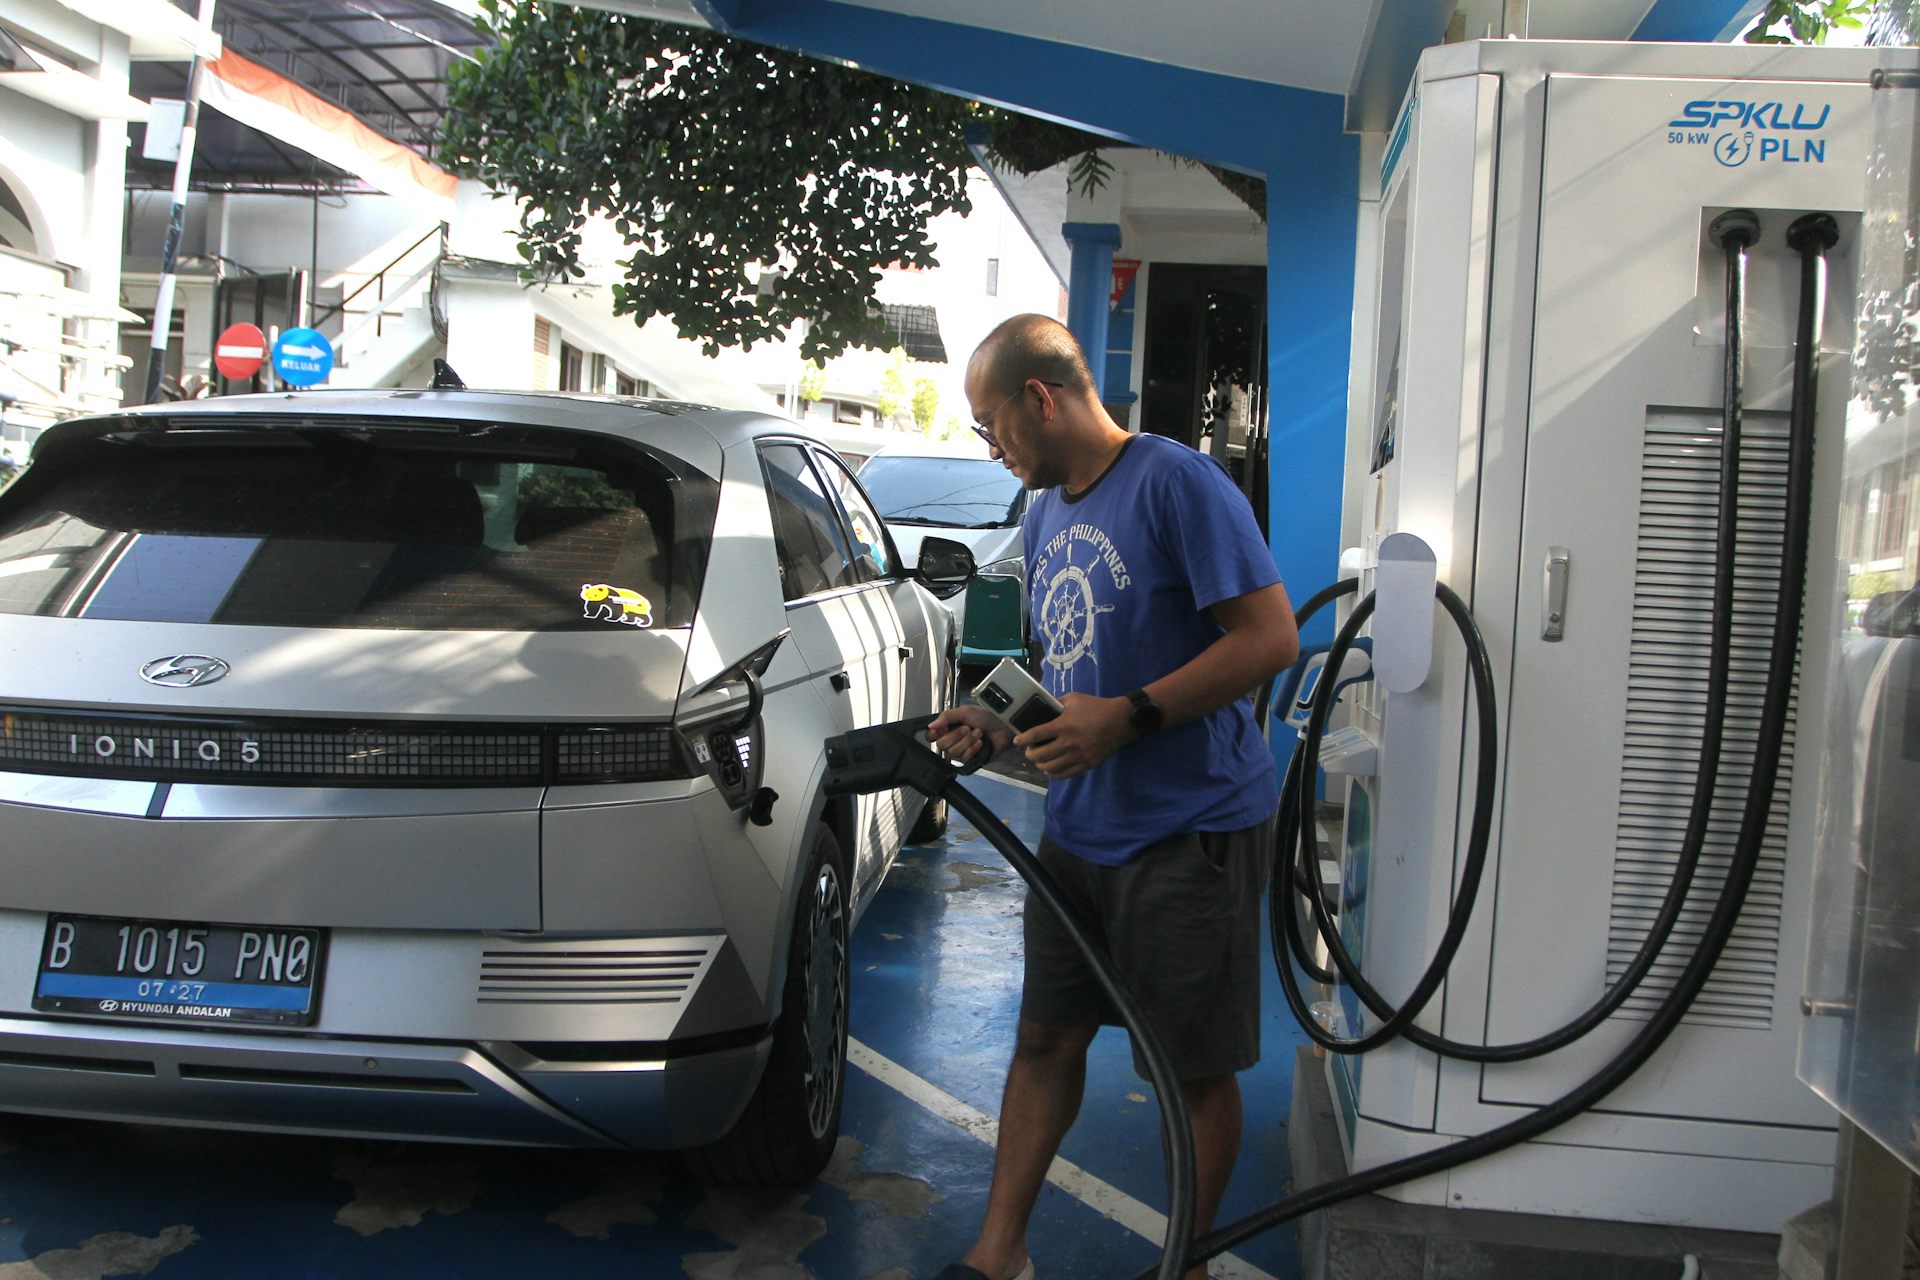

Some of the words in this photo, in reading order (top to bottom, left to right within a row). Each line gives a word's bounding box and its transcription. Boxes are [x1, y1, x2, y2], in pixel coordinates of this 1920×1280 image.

[1668, 100, 1831, 130] SPKLU
[1668, 132, 1683, 144] 50
[1687, 132, 1710, 145] kW
[1759, 138, 1825, 163] PLN
[281, 359, 321, 373] KELUAR
[1045, 529, 1067, 558] THE
[1069, 523, 1132, 591] PHILIPPINES
[70, 734, 221, 762] IONIQ
[241, 741, 260, 763] 5
[50, 921, 76, 969] B
[116, 925, 208, 976] 1015
[121, 1001, 174, 1014] HYUNDAI
[176, 1005, 231, 1018] ANDALAN
